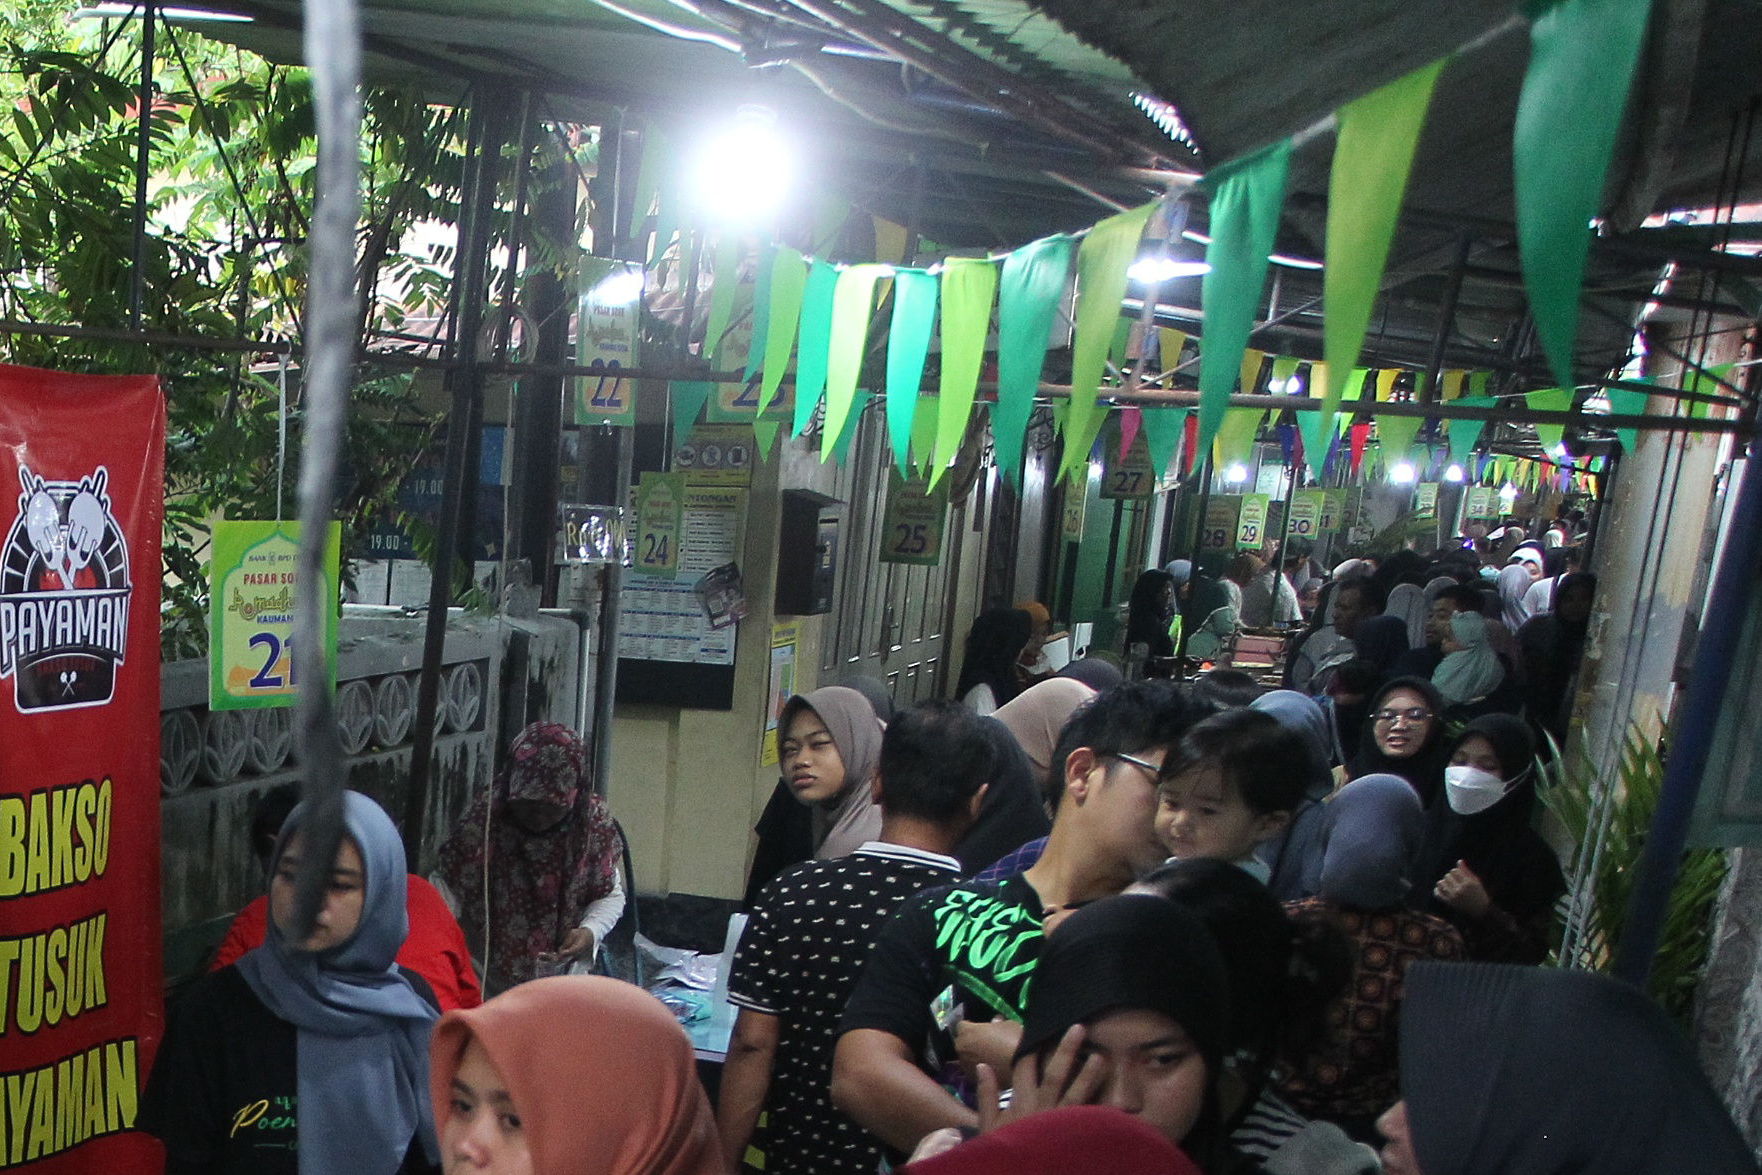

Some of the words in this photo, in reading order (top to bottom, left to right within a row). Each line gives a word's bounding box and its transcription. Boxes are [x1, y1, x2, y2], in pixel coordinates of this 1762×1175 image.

[590, 357, 622, 407] 22
[1114, 471, 1143, 493] 27
[894, 522, 928, 554] 25
[1203, 529, 1226, 548] 28
[1241, 524, 1257, 543] 29
[1288, 518, 1311, 534] 30
[370, 534, 400, 551] 19.00
[643, 532, 669, 566] 24
[244, 573, 277, 585] PASAR
[0, 596, 127, 667] PAYAMAN
[249, 631, 301, 689] 21
[229, 1098, 297, 1138] Poen
